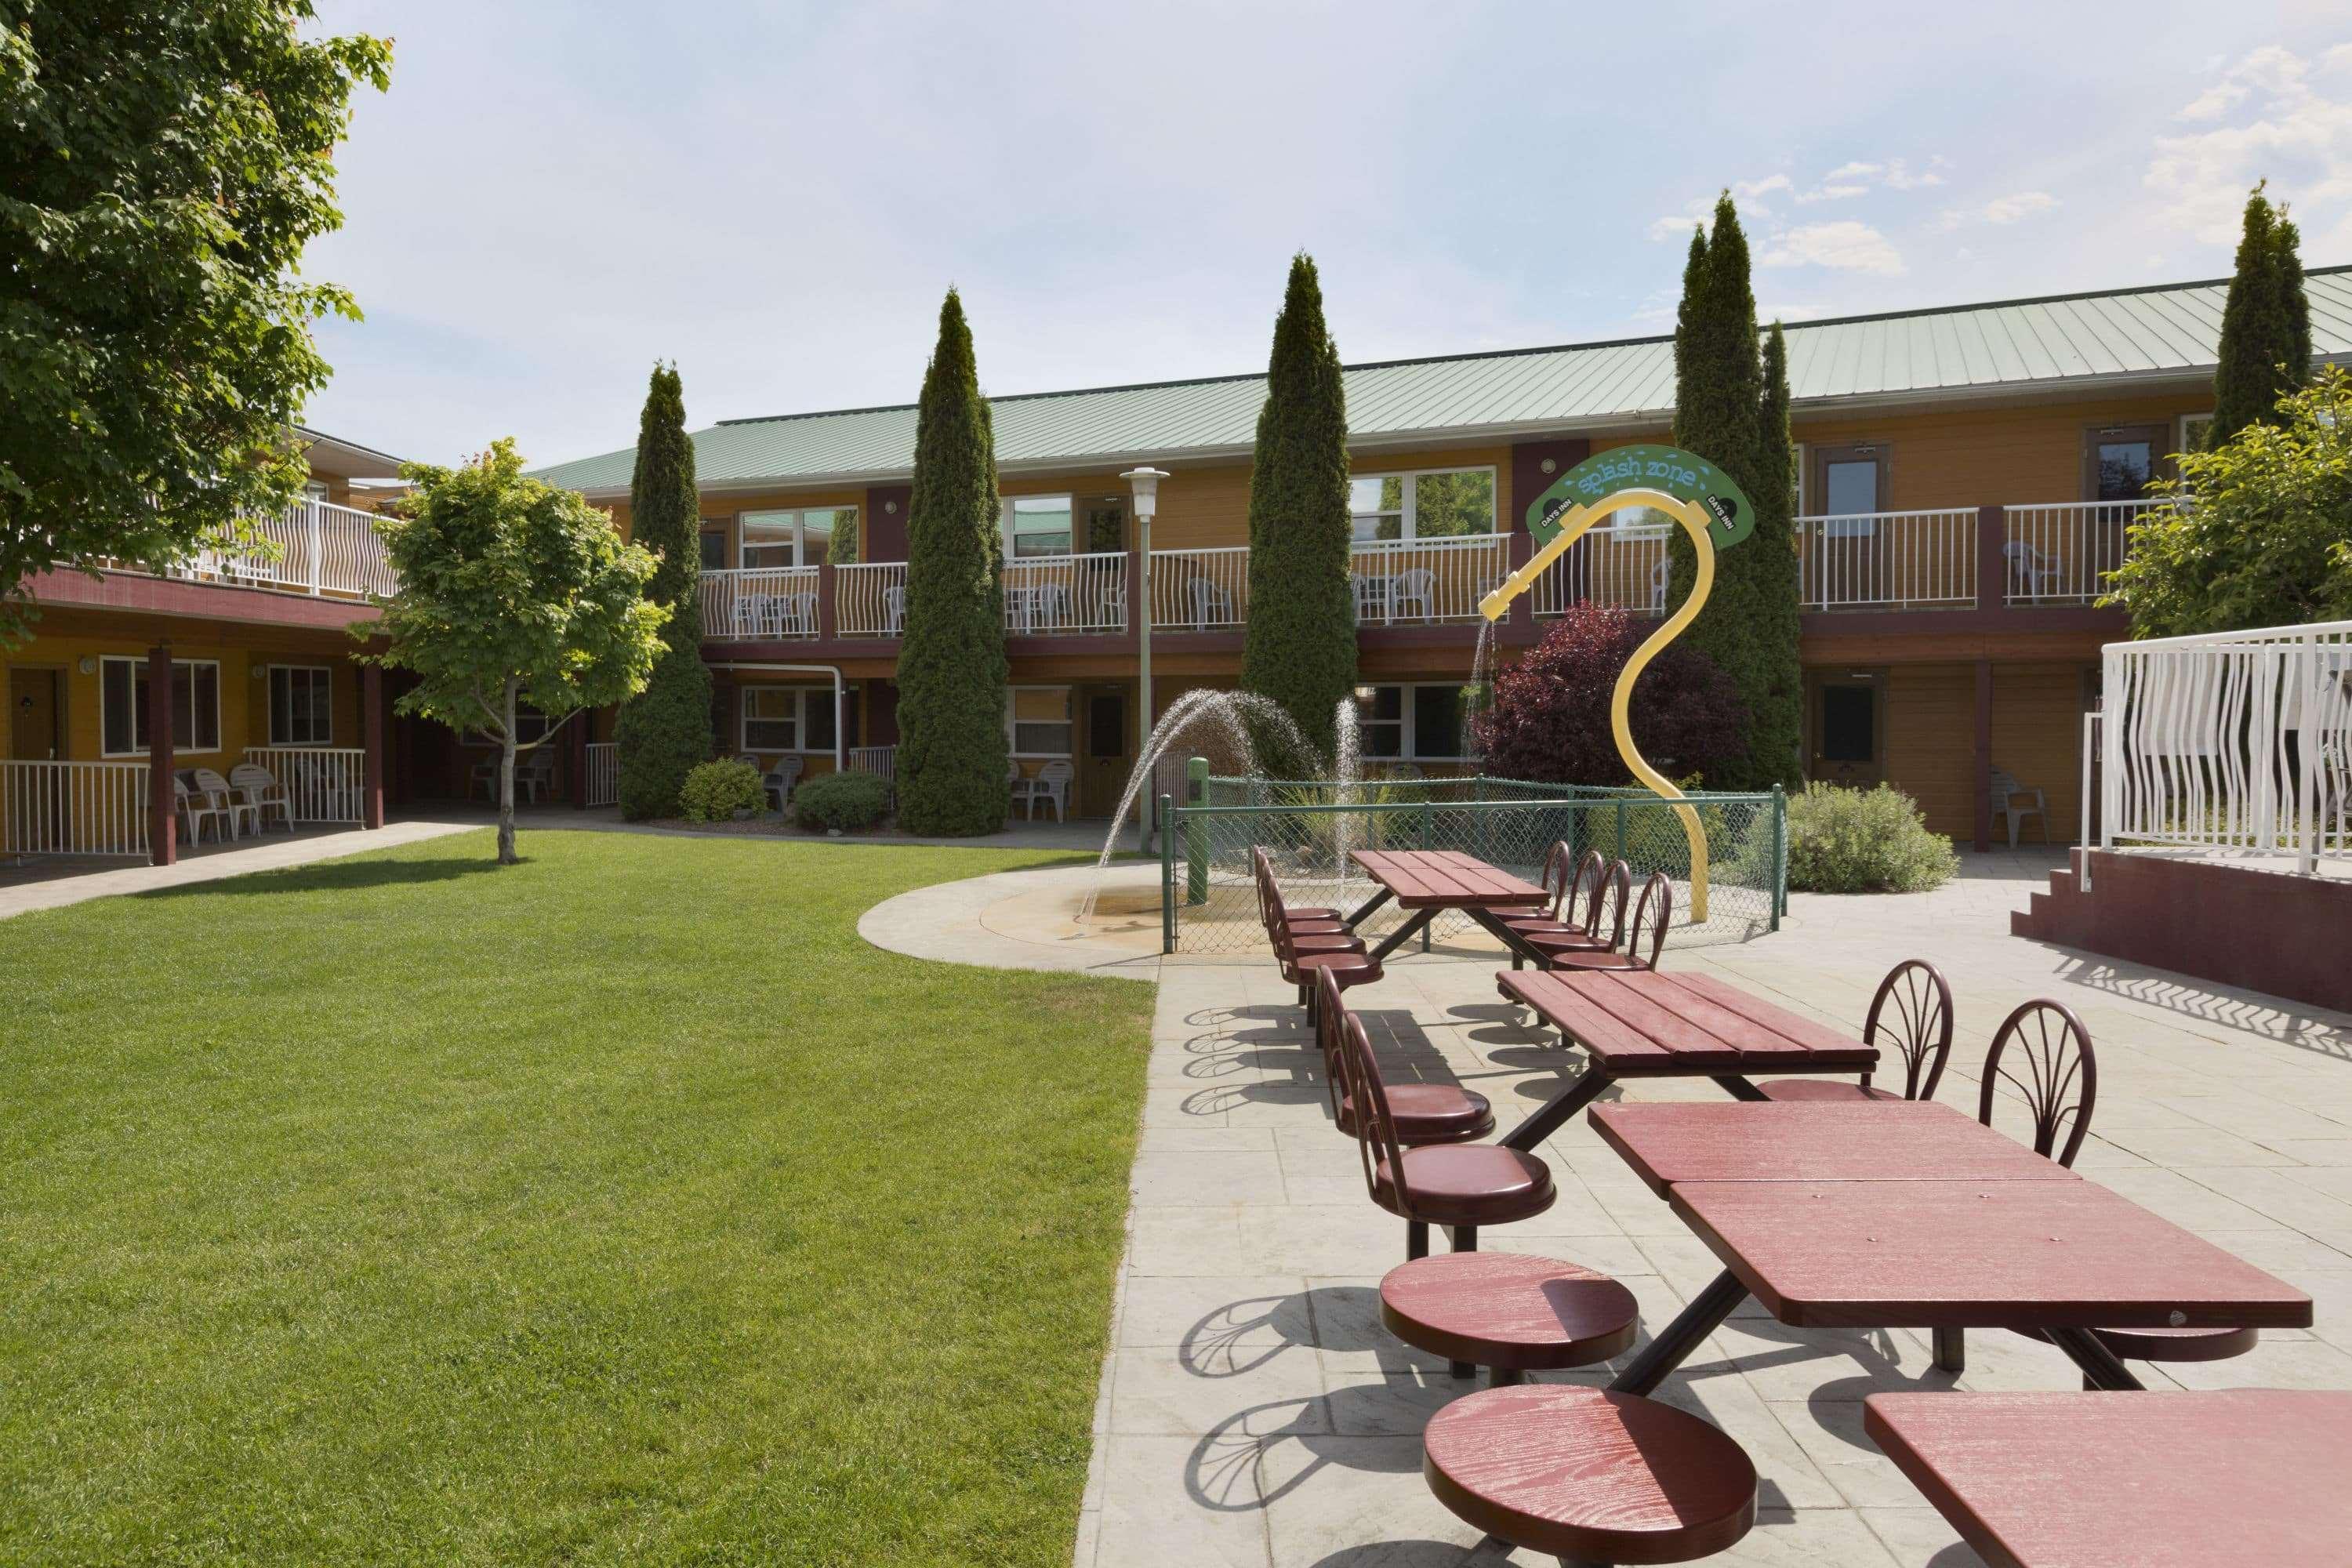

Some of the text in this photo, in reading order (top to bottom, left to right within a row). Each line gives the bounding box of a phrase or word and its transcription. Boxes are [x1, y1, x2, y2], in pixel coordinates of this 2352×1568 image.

[1578, 456, 1696, 494] splash zone
[1541, 499, 1572, 527] DAYS INN
[1708, 496, 1734, 530] DAYS INN
